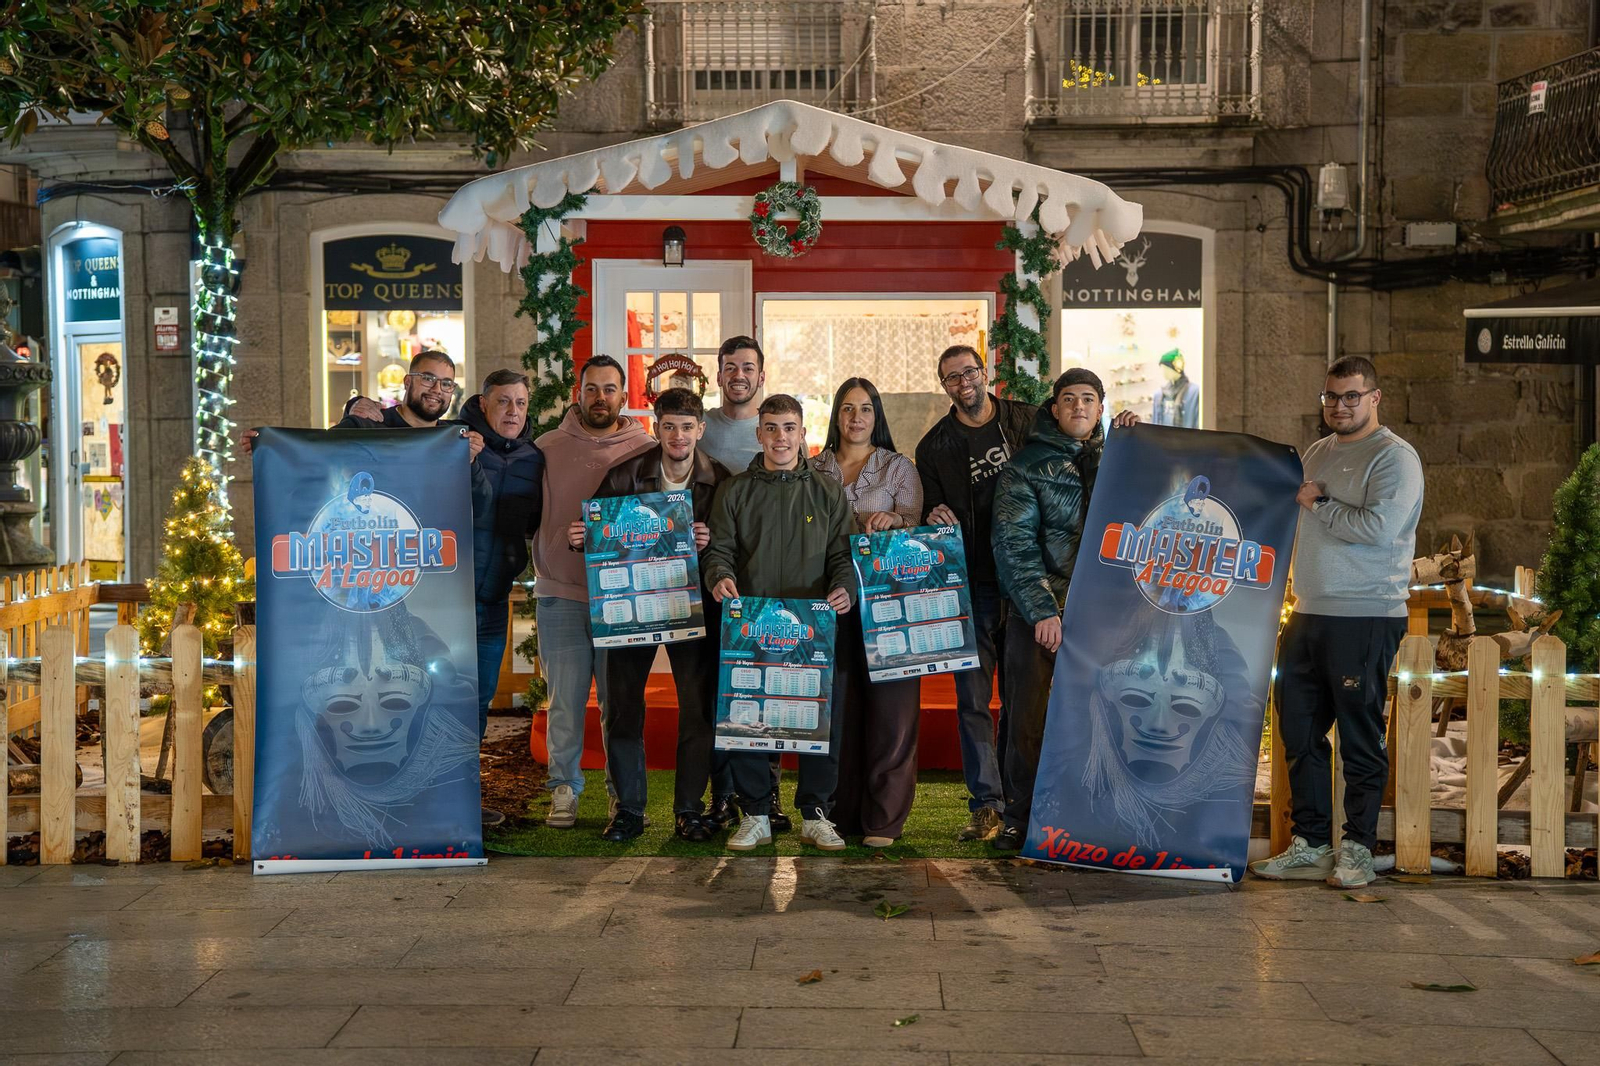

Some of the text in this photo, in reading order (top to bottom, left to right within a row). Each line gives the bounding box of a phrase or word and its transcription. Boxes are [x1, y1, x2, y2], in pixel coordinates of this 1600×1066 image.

[91, 275, 97, 287] &
[325, 283, 463, 302] TOP QUEENS
[1062, 288, 1200, 302] NOTTINGHAM
[1502, 333, 1566, 350] Estrella Galicia
[667, 493, 686, 503] 2026
[329, 515, 399, 531] Futbolín
[609, 516, 669, 538] MASTER
[936, 526, 955, 536] 2026
[1161, 516, 1224, 537] Futbolín
[621, 532, 659, 543] A Lagoa
[289, 528, 445, 571] MASTER
[1116, 522, 1262, 581] MASTER
[879, 549, 939, 571] MASTER
[316, 562, 416, 594] A Lagoa
[892, 565, 930, 576] A Lagoa
[1135, 559, 1229, 597] A Lagoa
[811, 603, 830, 611] 2026
[747, 621, 809, 639] MASTER
[768, 635, 798, 647] Lagoa
[1037, 825, 1108, 862] Xinzo
[1112, 845, 1146, 869] de
